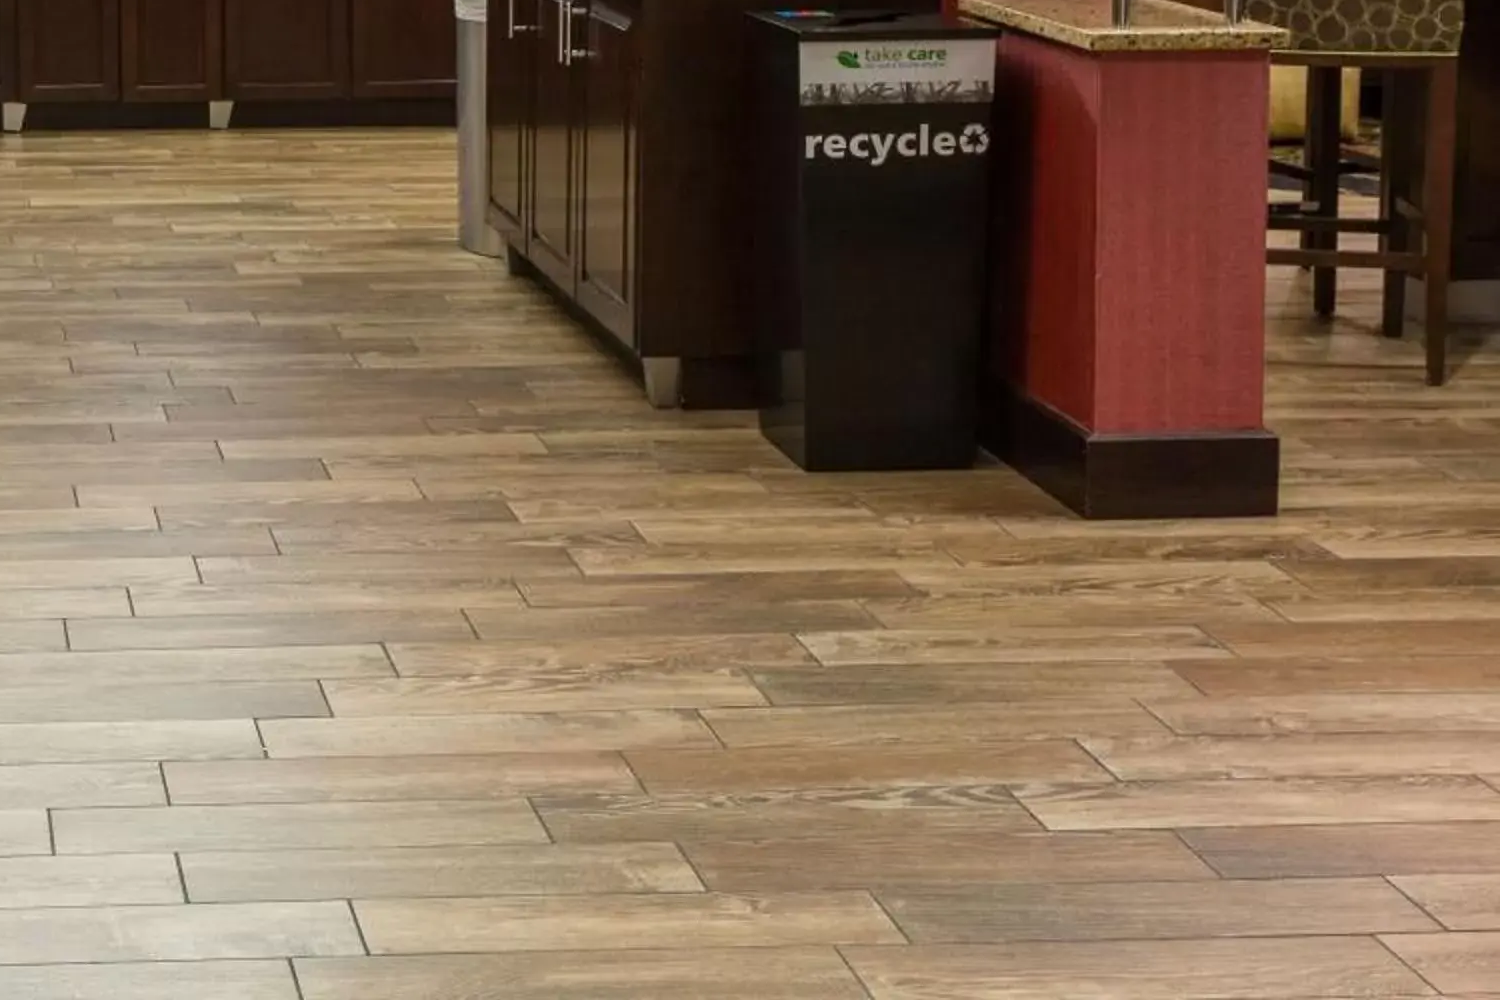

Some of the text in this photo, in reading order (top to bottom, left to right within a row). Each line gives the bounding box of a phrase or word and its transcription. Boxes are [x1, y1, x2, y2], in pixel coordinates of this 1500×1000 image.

[865, 47, 947, 62] take care
[805, 123, 957, 167] recycle
